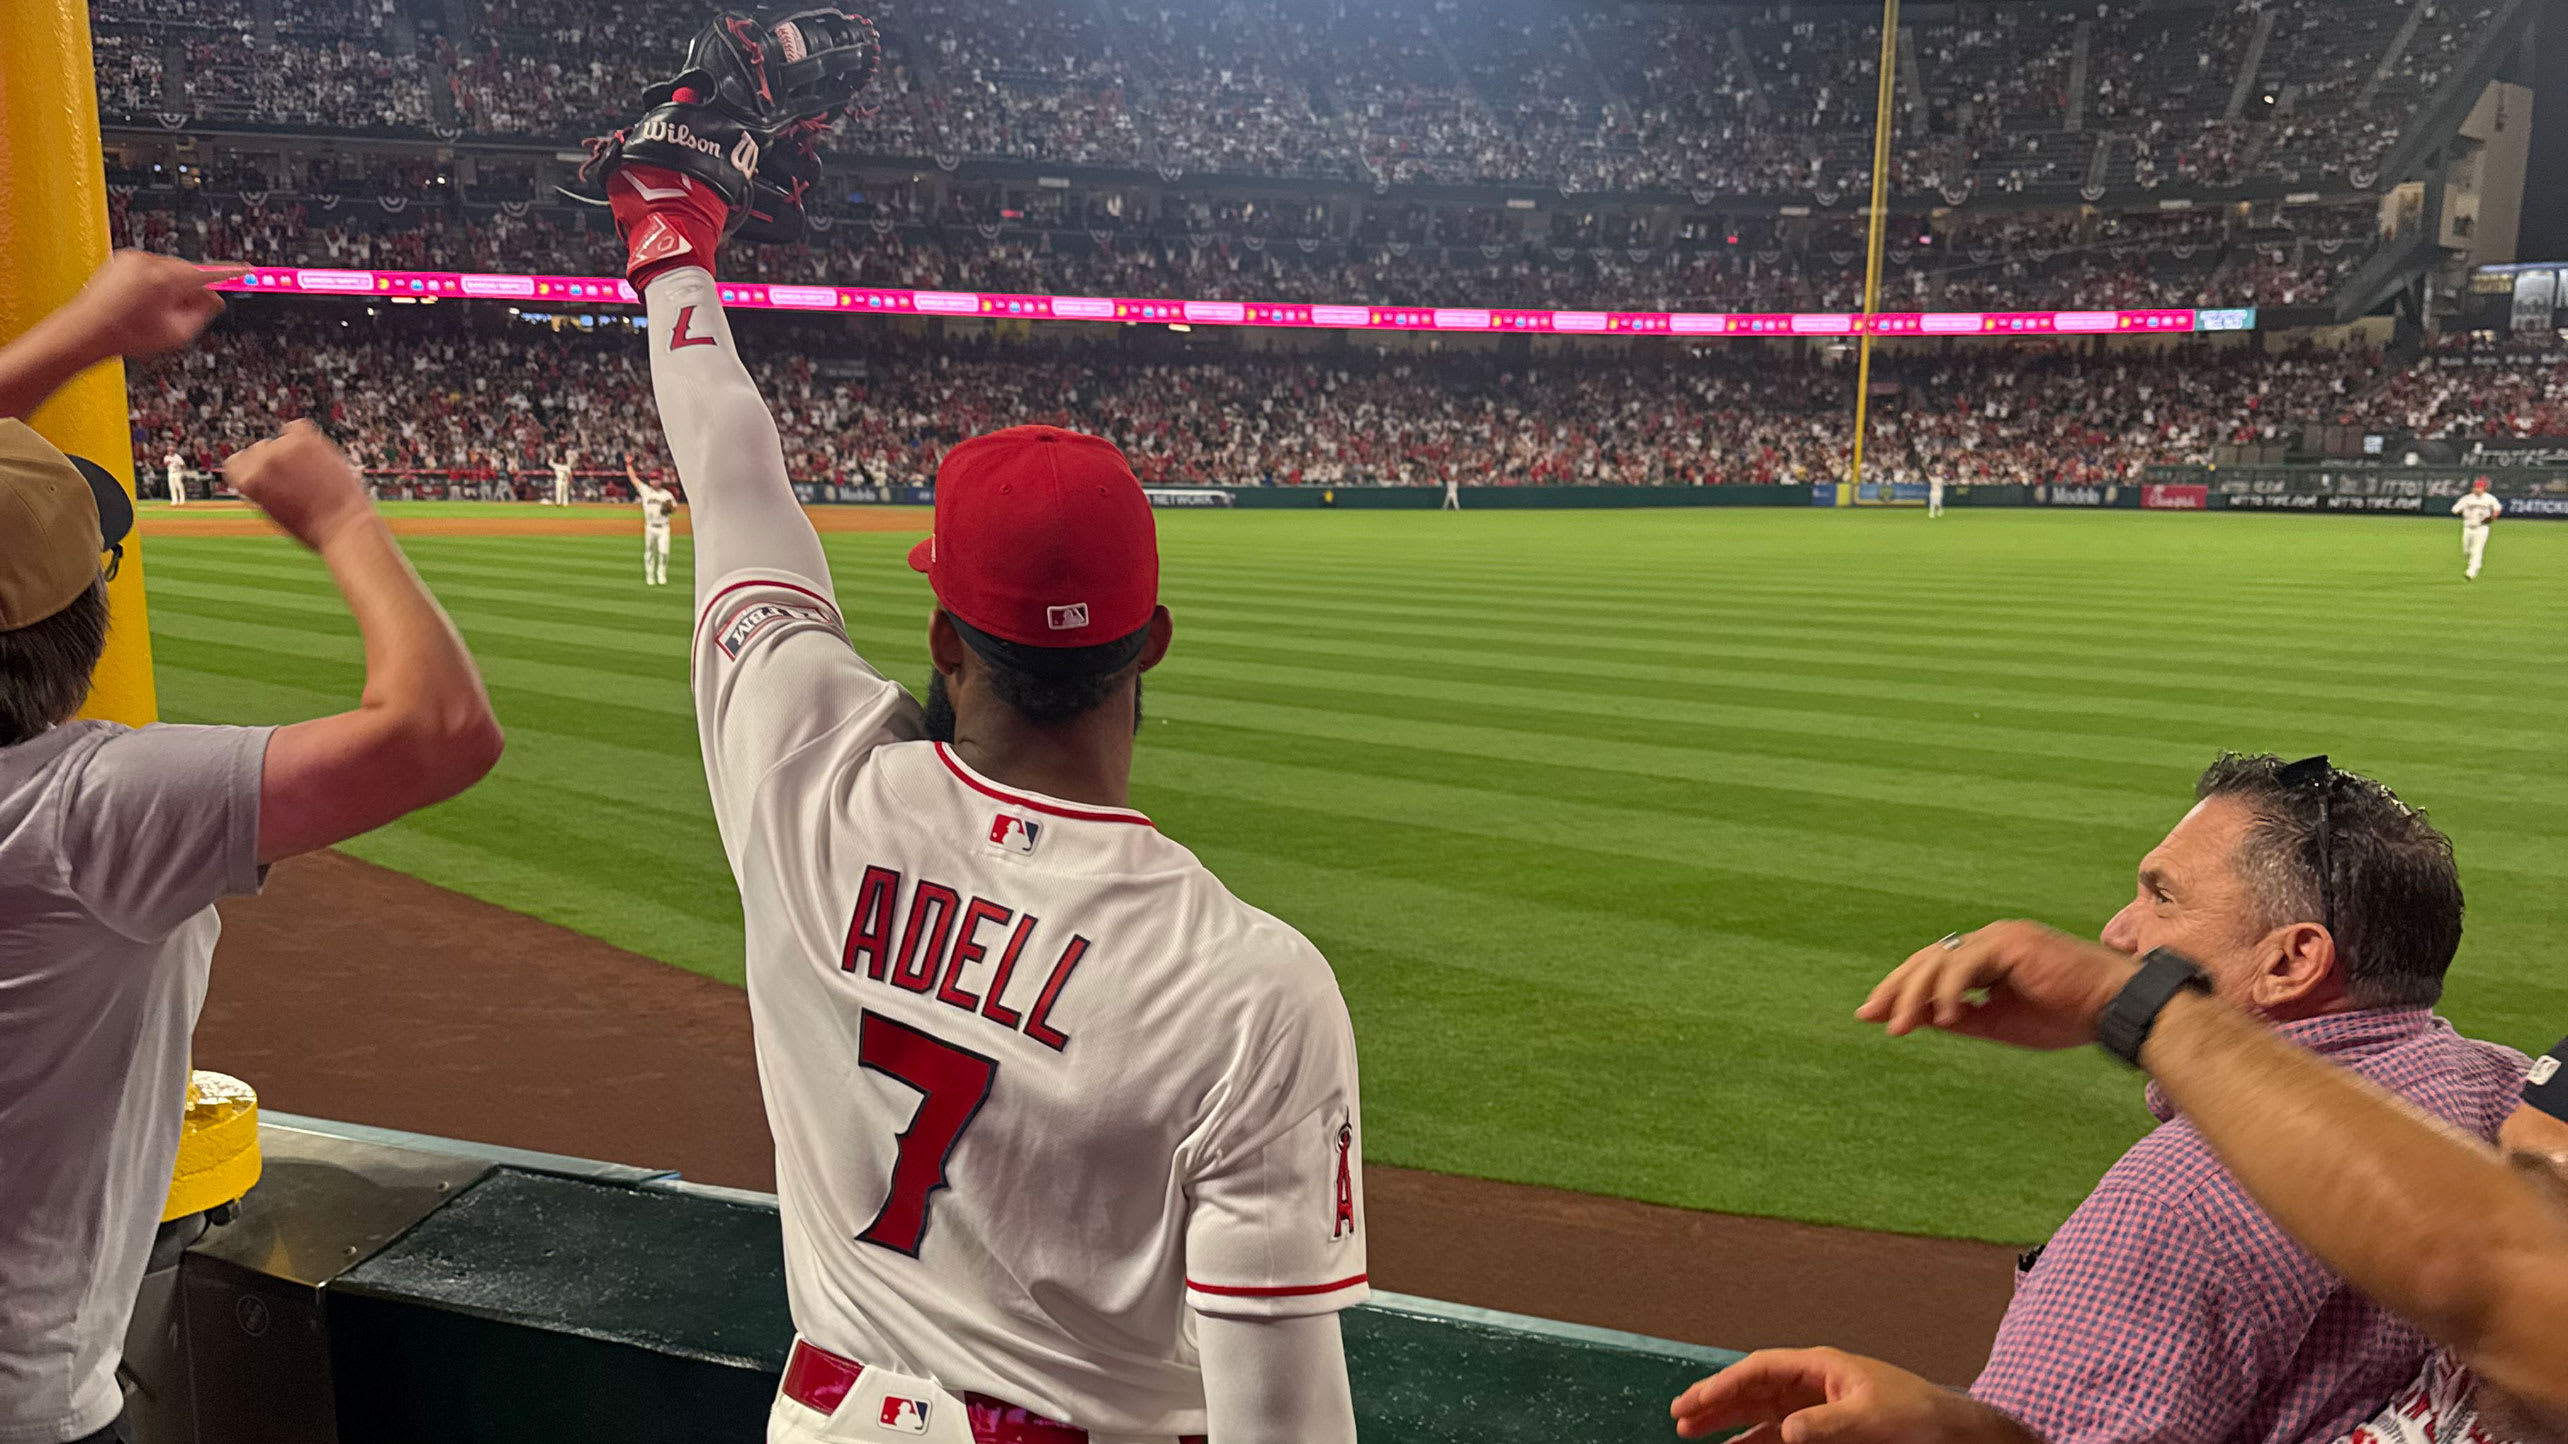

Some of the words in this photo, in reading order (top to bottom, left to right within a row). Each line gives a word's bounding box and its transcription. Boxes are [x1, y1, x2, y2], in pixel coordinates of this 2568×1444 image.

[643, 121, 721, 158] Wilson
[670, 305, 718, 352] 7
[841, 865, 1091, 1052] ADELL
[854, 1007, 999, 1260] 7
